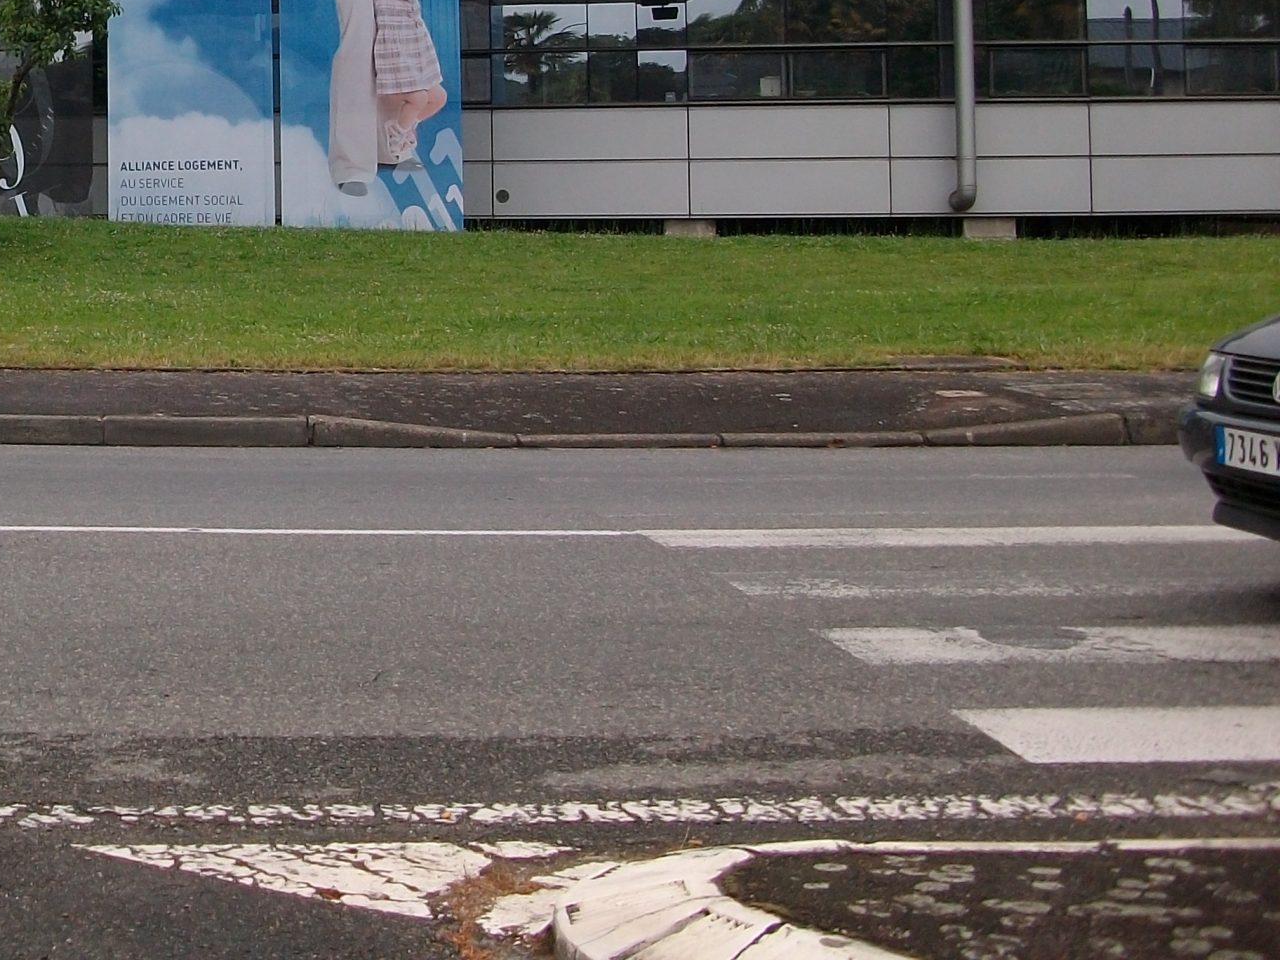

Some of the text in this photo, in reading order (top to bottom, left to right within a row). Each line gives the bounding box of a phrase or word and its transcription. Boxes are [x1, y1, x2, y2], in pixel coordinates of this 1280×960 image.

[120, 159, 243, 172] ALLIANCE LOGEMENT,
[120, 177, 185, 189] AU SERVICE
[121, 194, 244, 207] DU LOGEMENT SOCIAL
[121, 213, 134, 222] ET
[137, 213, 153, 223] DU
[156, 212, 193, 224] CADRE
[197, 212, 212, 224] DE
